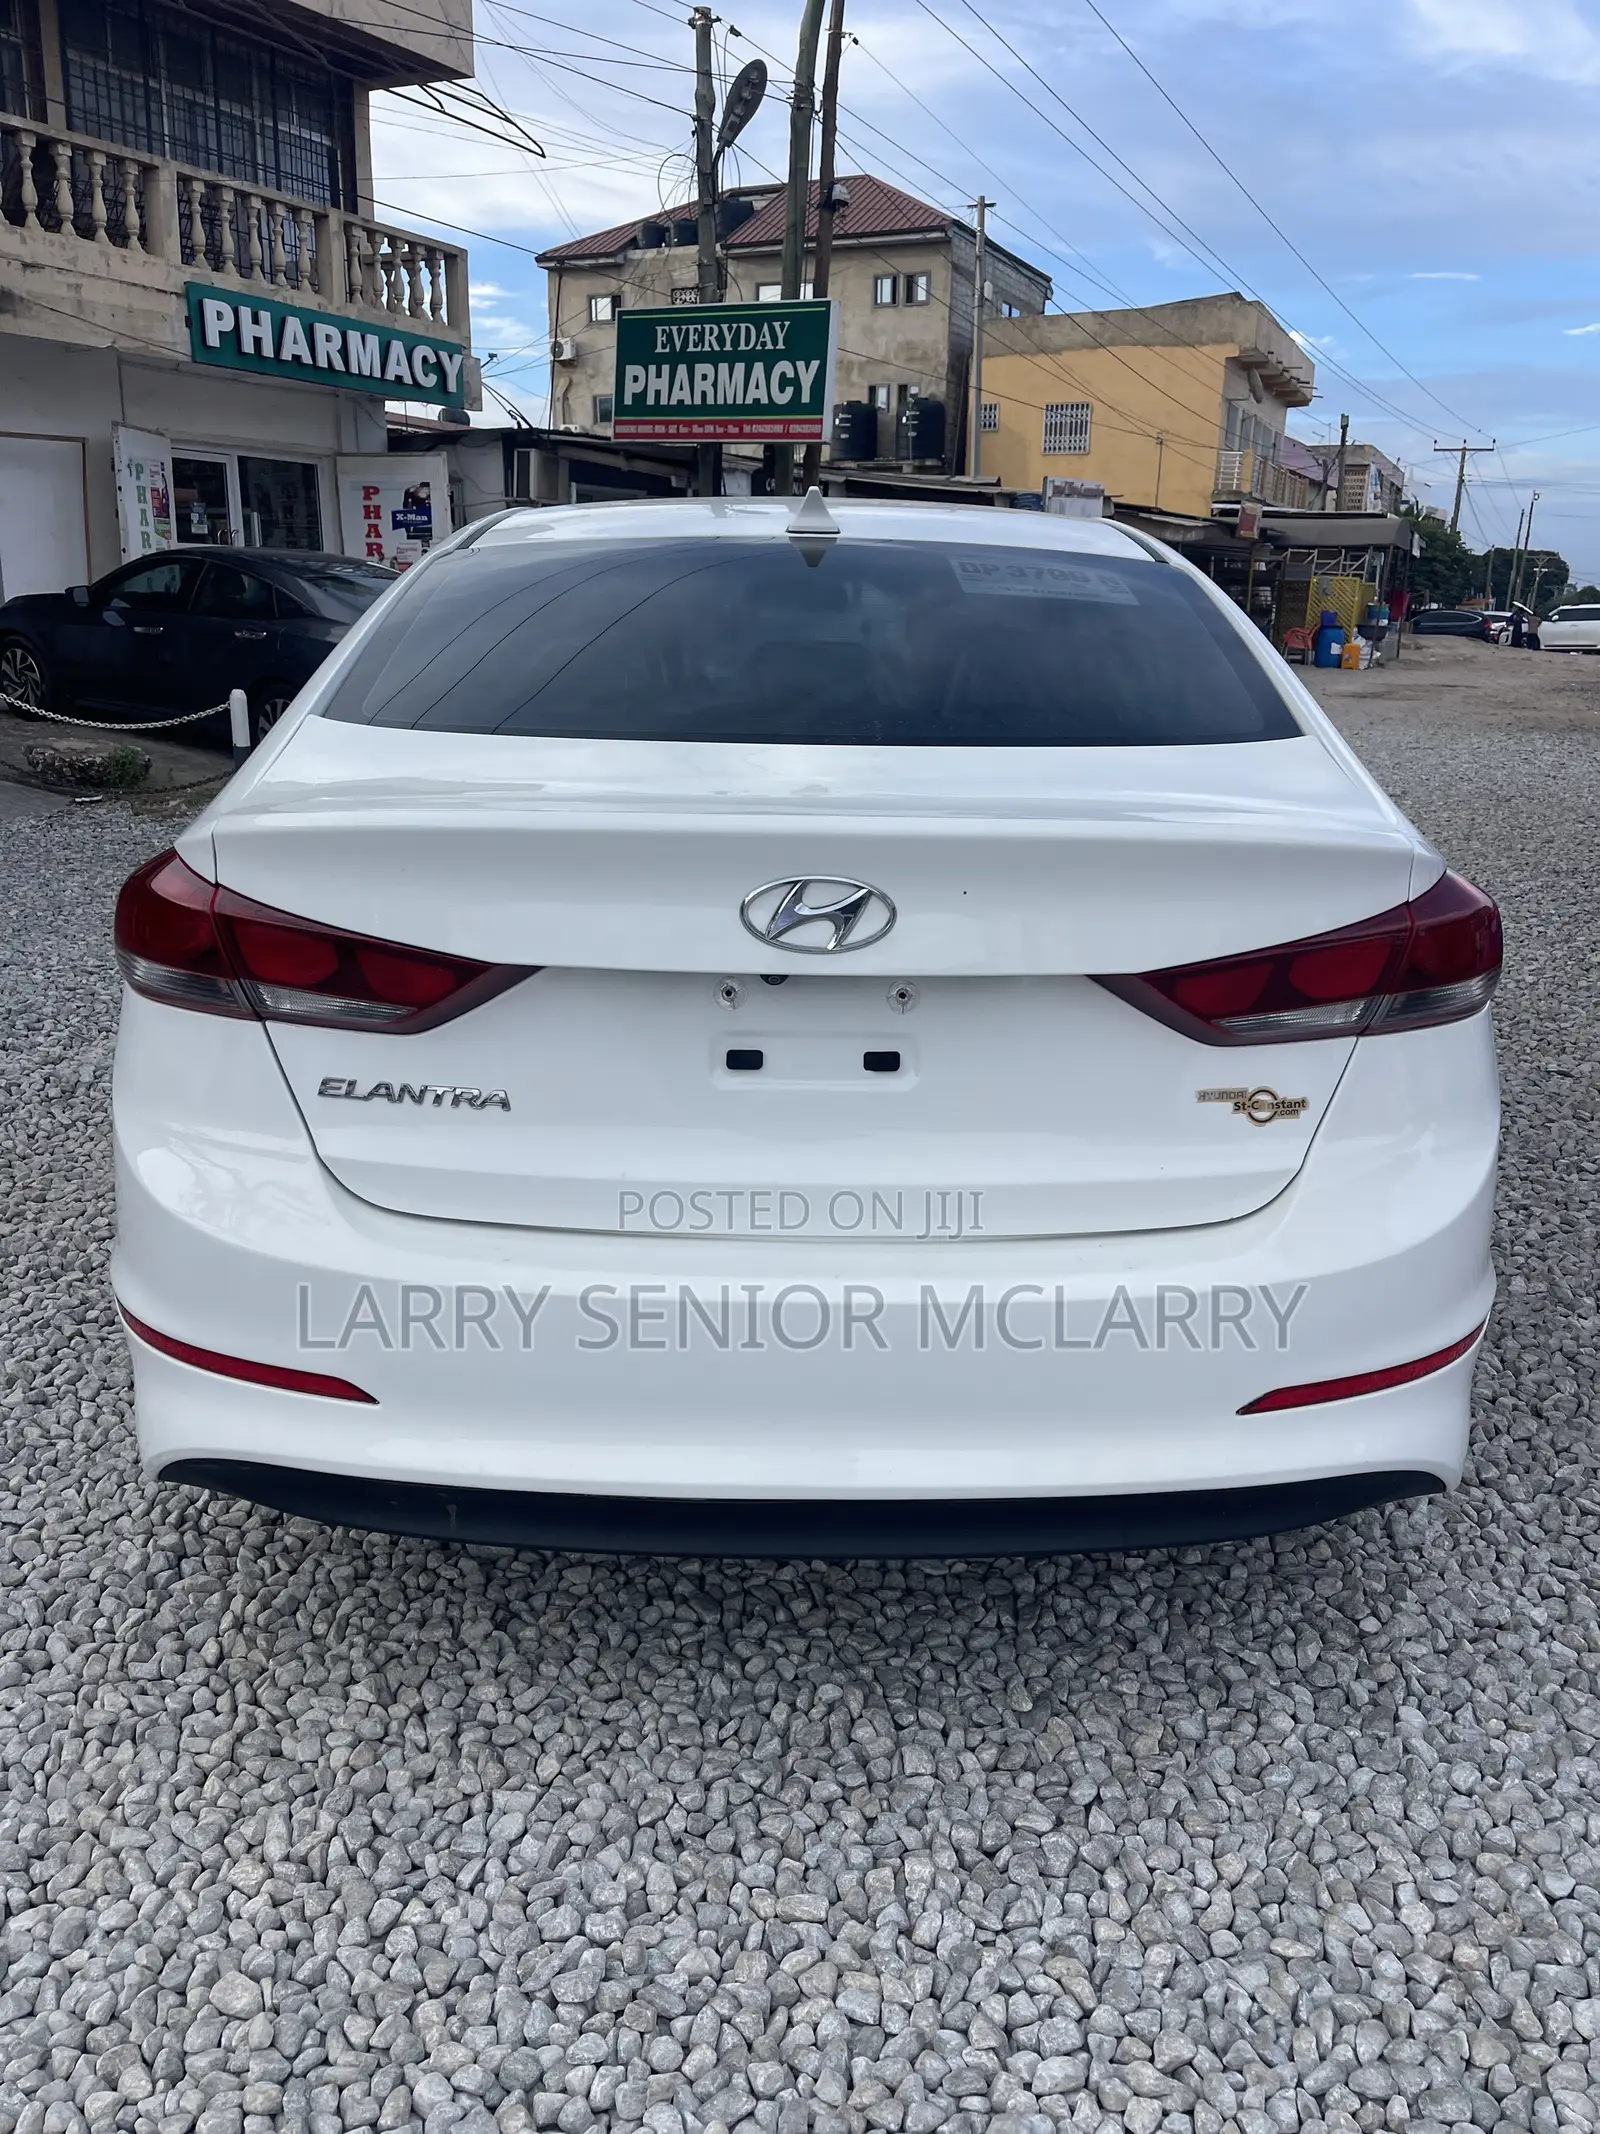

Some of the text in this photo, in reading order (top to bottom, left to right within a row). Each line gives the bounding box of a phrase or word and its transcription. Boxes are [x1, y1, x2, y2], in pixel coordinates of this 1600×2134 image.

[202, 297, 464, 393] PHARMACY
[654, 321, 790, 353] EVERYDAY
[623, 360, 820, 405] PHARMACY
[395, 513, 428, 521] X-Man
[317, 1076, 511, 1112] ELANTRA
[1233, 1099, 1306, 1110] St-Cnstant
